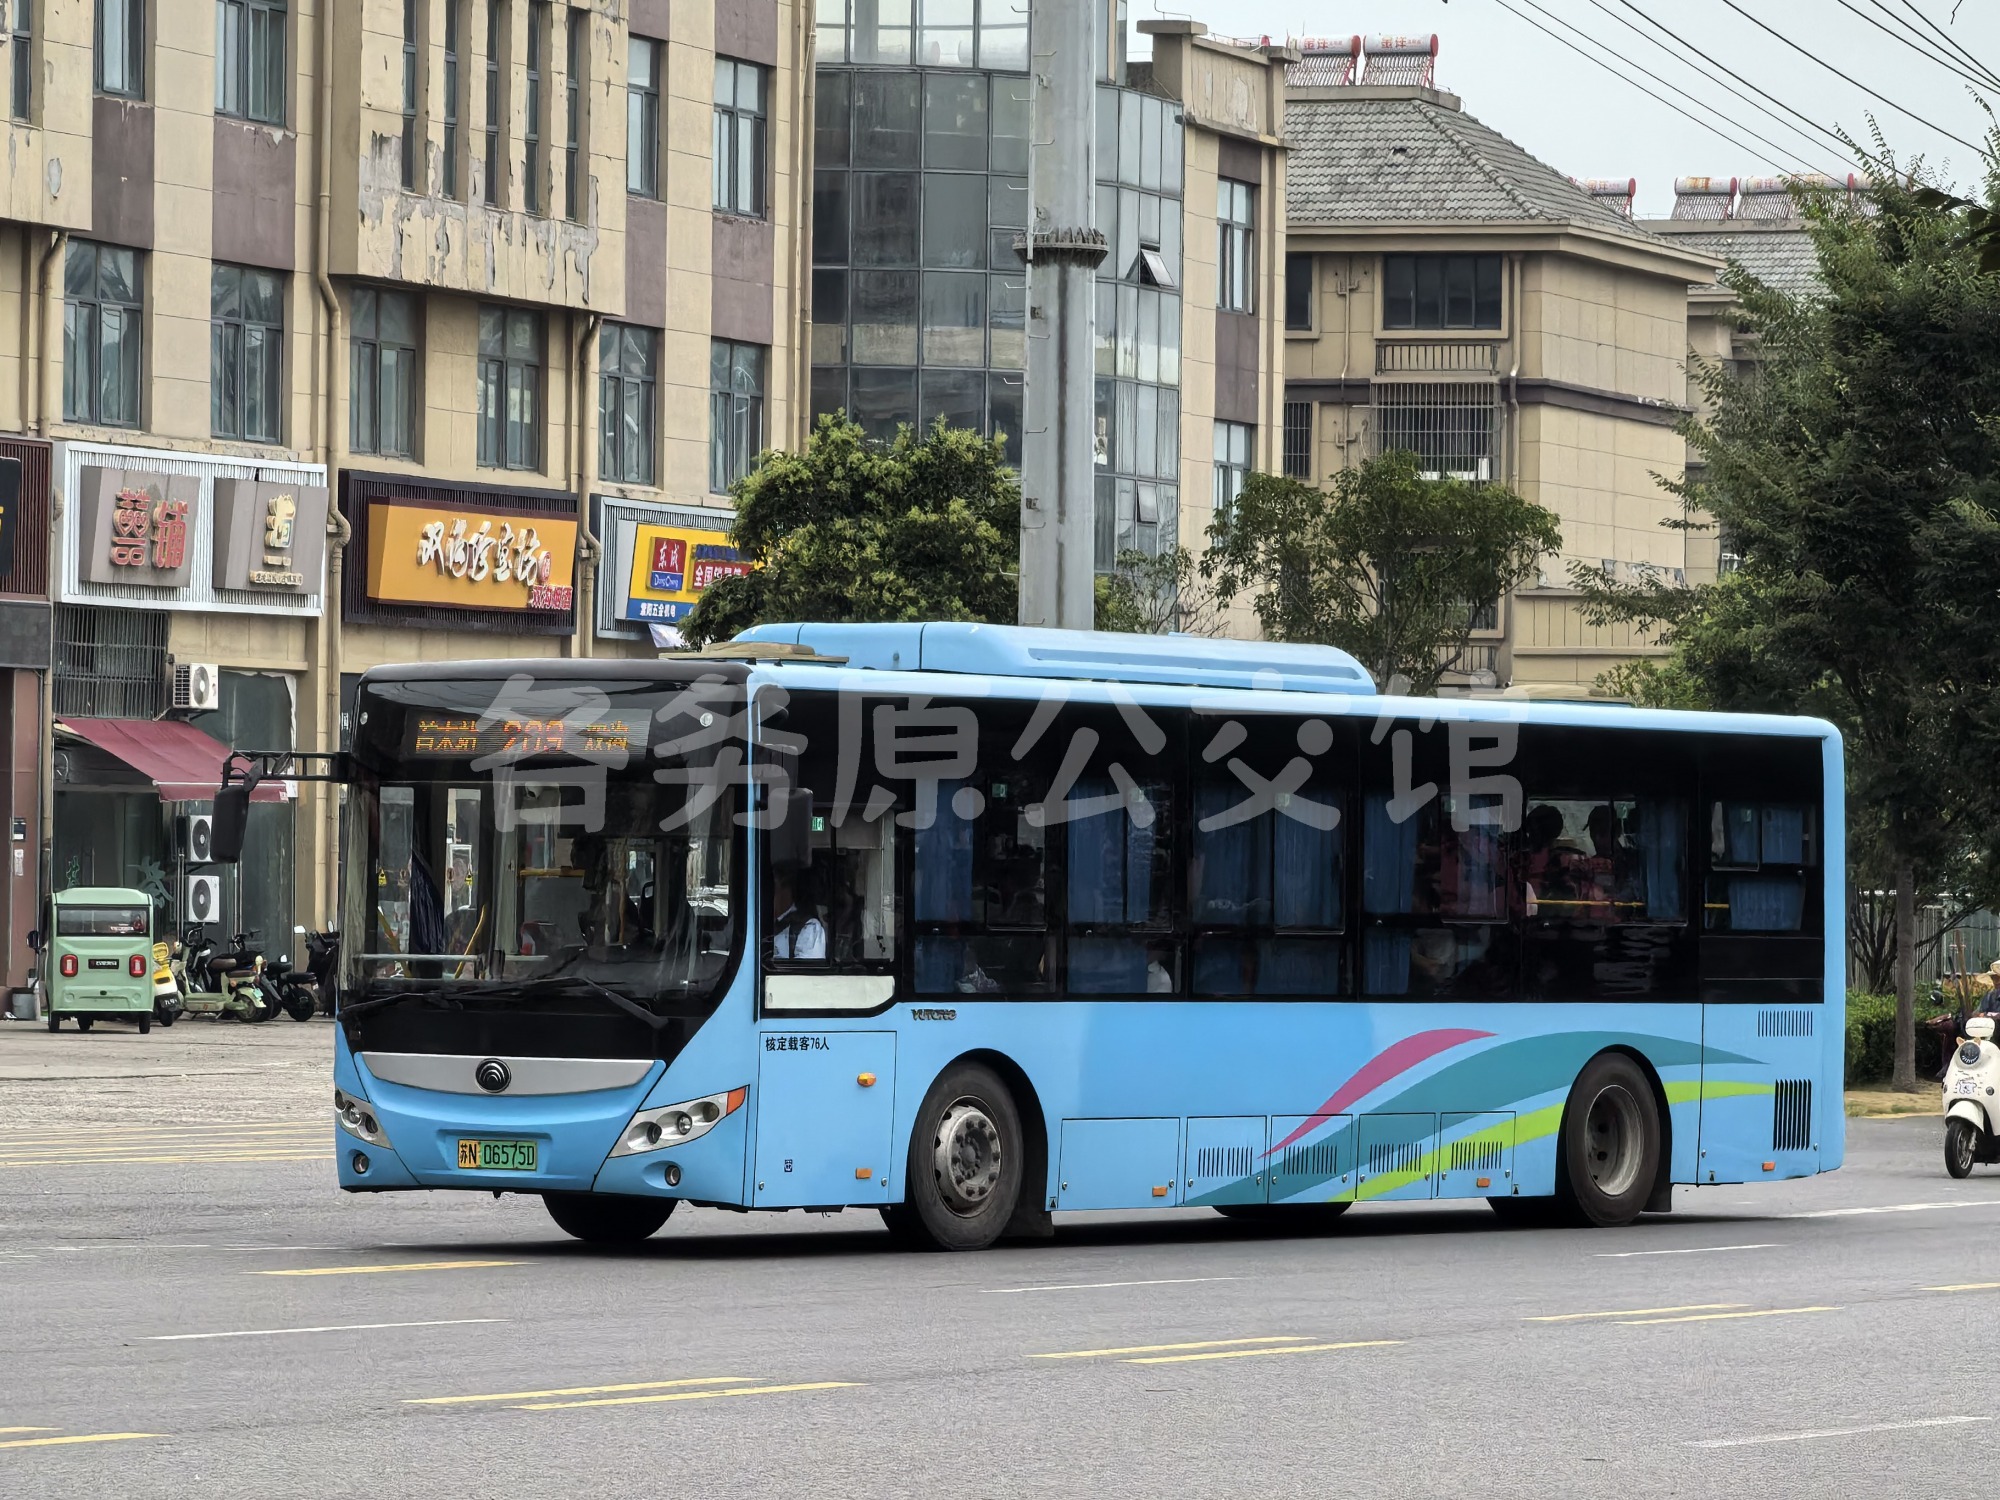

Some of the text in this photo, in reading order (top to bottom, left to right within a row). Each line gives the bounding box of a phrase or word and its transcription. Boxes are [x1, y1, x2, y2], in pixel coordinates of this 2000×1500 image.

[503, 720, 564, 752] 209
[765, 1036, 830, 1051] 核定载客76人
[460, 1142, 477, 1164] 苏N
